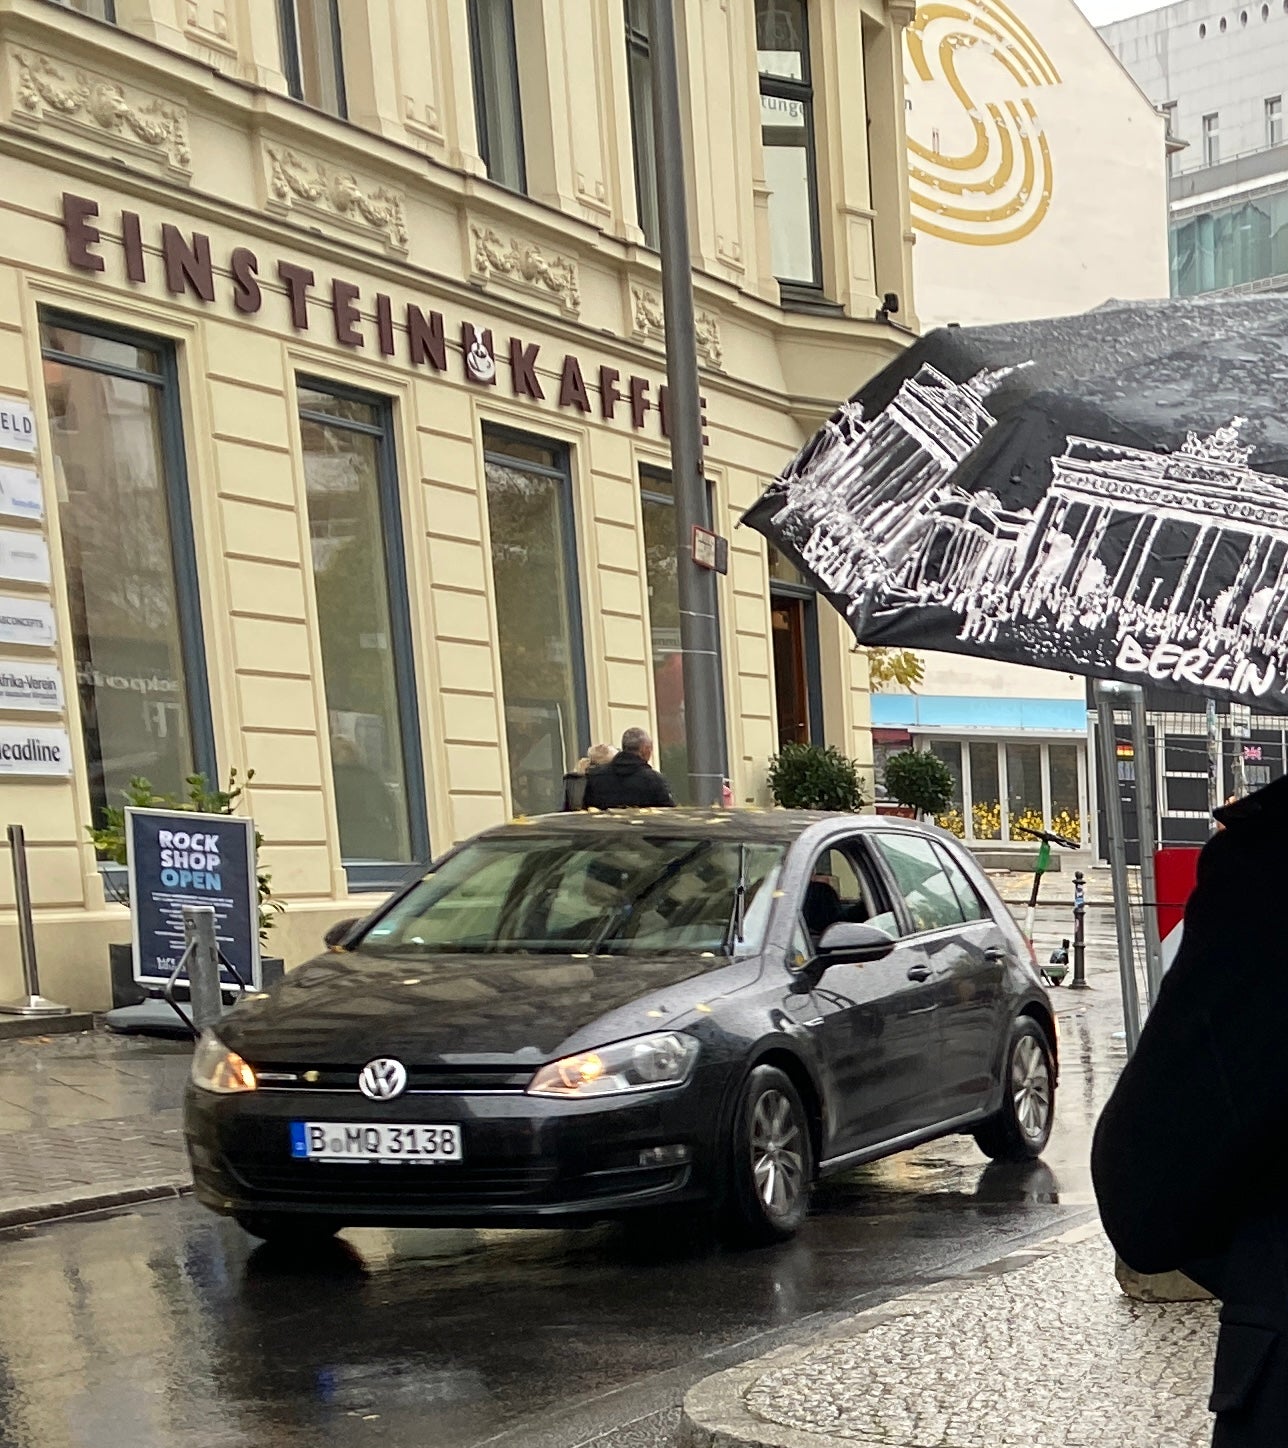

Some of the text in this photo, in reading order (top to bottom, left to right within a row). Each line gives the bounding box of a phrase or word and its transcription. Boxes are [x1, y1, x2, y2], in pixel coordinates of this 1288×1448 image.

[62, 191, 447, 373] EINSTEIN
[1115, 633, 1277, 697] BERLIN
[158, 829, 220, 853] ROCK
[160, 850, 221, 872] SHOP
[160, 868, 222, 891] OPEN
[309, 1126, 456, 1155] B MQ 3138
